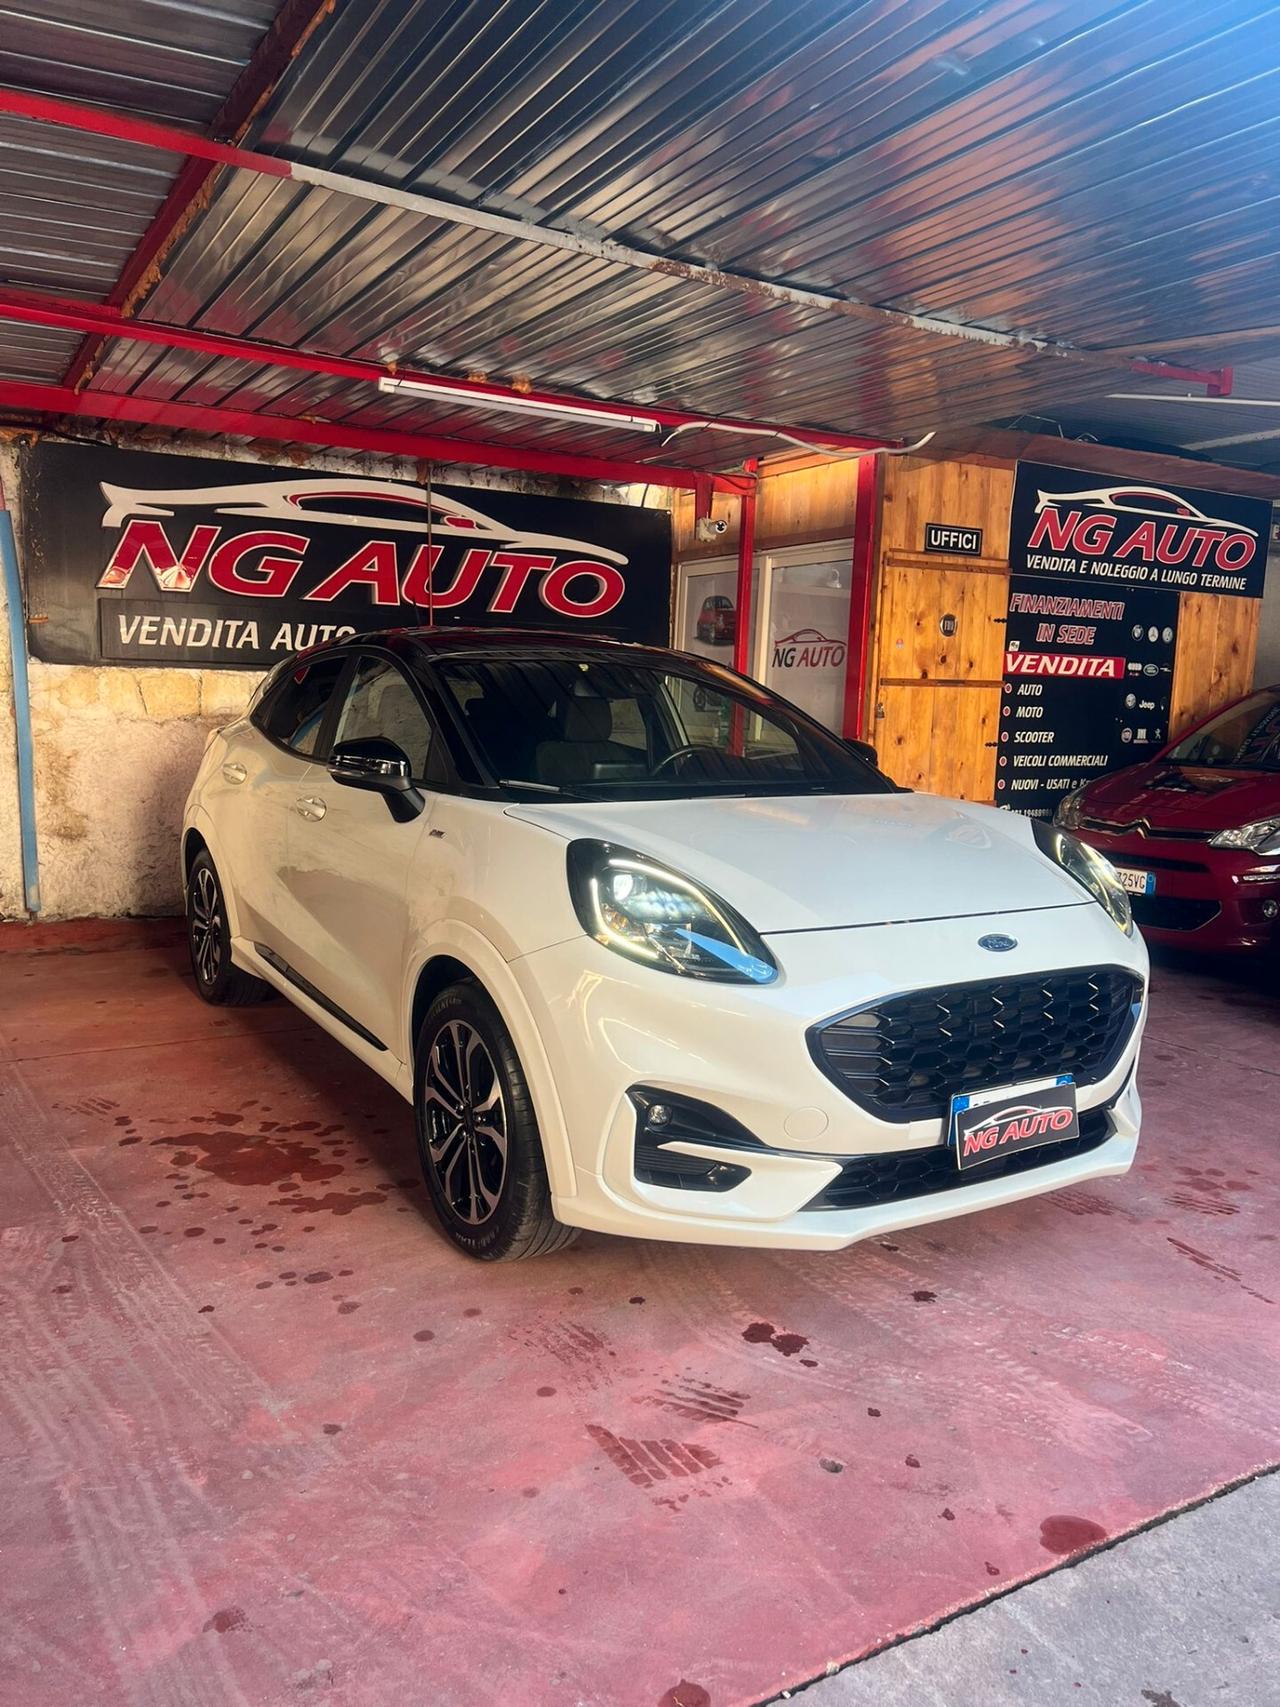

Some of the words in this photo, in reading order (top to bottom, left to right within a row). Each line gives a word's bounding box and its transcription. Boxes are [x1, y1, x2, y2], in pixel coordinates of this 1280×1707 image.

[930, 529, 978, 550] UFFICI
[1027, 508, 1117, 555] NG
[1112, 521, 1256, 571] AUTO
[97, 519, 310, 600] NG
[303, 540, 626, 618] AUTO
[1026, 554, 1077, 573] VENDITA
[1079, 560, 1089, 574] E
[1090, 562, 1149, 580] NOLEGGIO
[1149, 568, 1159, 582] A
[1161, 569, 1198, 586] LUNGO
[1200, 573, 1247, 590] TERMINE
[1009, 592, 1126, 621] FINANZIAMENTI
[118, 613, 260, 650] VENDITA
[1036, 622, 1056, 643] IN
[1056, 624, 1097, 646] SEDE
[771, 646, 797, 668] NG
[796, 646, 846, 668] AUTO
[1005, 653, 1115, 678] VENDITA
[1017, 683, 1043, 696] AUTO
[1015, 706, 1044, 719] MOTO
[1138, 699, 1156, 710] Jeep
[1014, 731, 1055, 744] SCOOTER
[1013, 755, 1047, 767] VEICOLI
[1048, 755, 1109, 767] COMMERCIALI
[1011, 779, 1039, 791] NUOVI
[1046, 779, 1071, 790] USATI
[963, 1125, 999, 1157] NG
[999, 1109, 1073, 1145] AUTO
